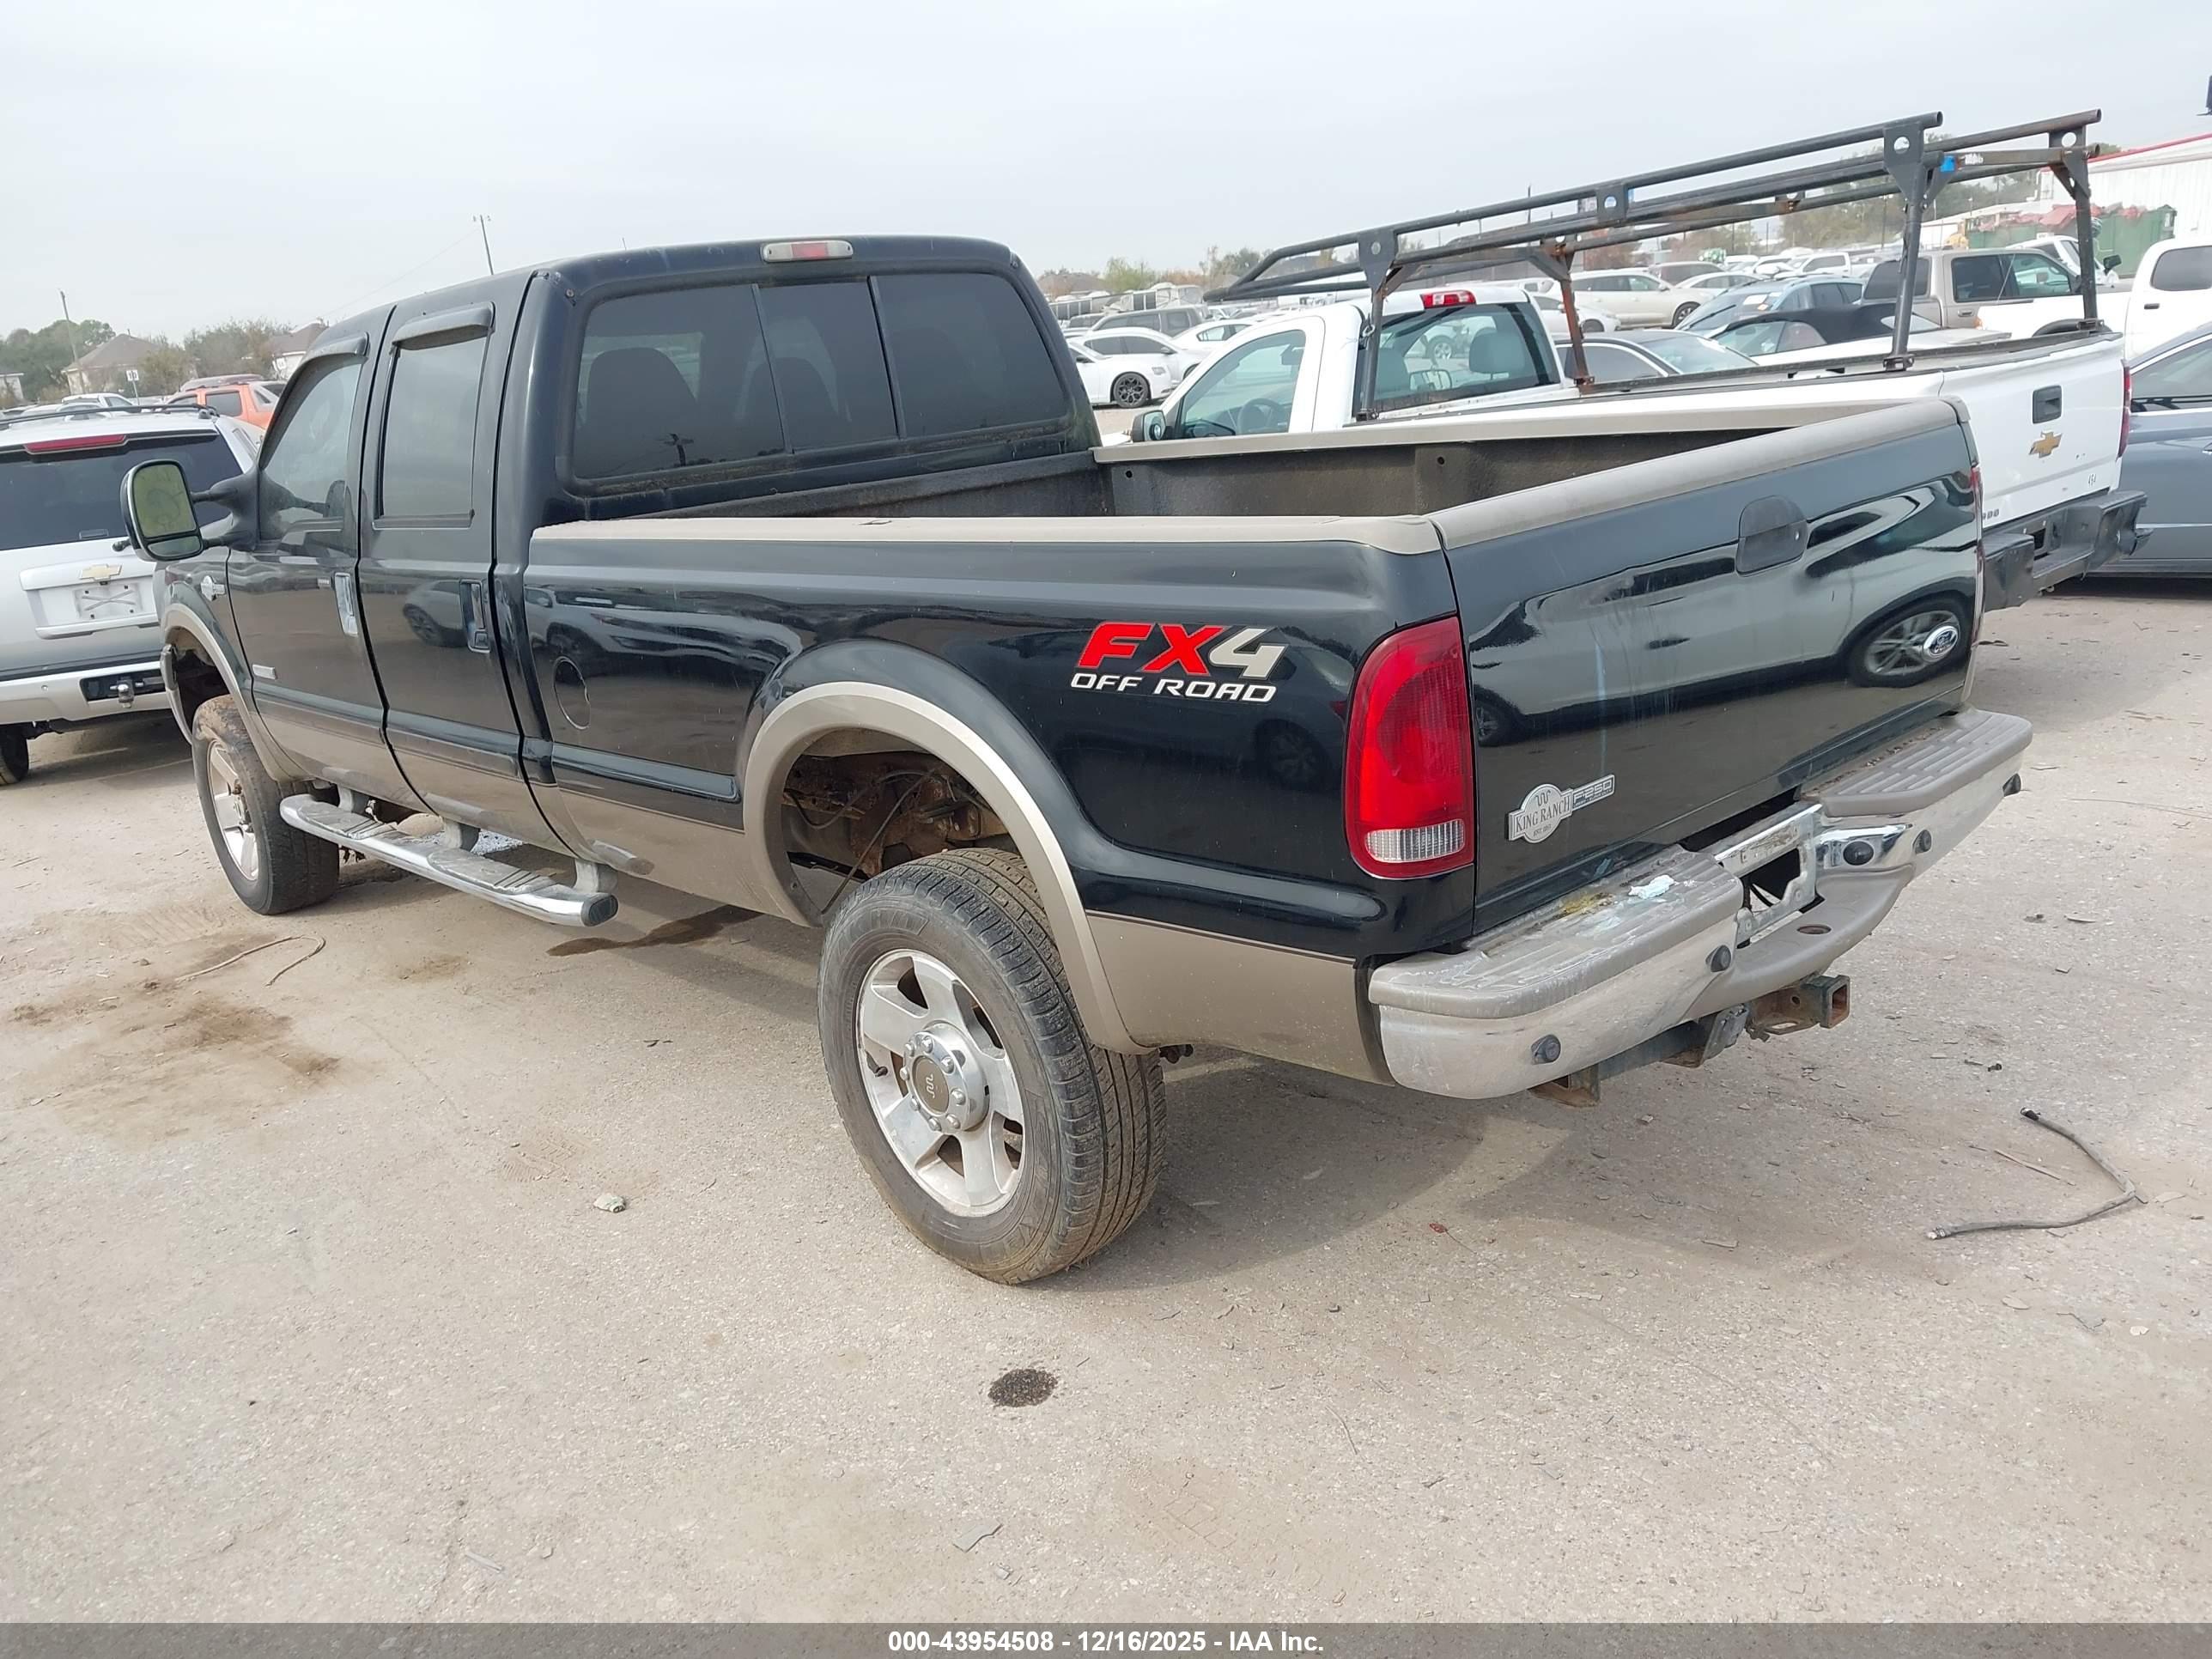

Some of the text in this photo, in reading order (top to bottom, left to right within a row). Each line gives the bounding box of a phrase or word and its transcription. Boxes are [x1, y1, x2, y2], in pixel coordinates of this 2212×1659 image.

[1077, 622, 1287, 680] FX4
[1070, 672, 1278, 702] OFF ROAD
[1515, 811, 1539, 834] KING
[1540, 795, 1571, 823] RANCH
